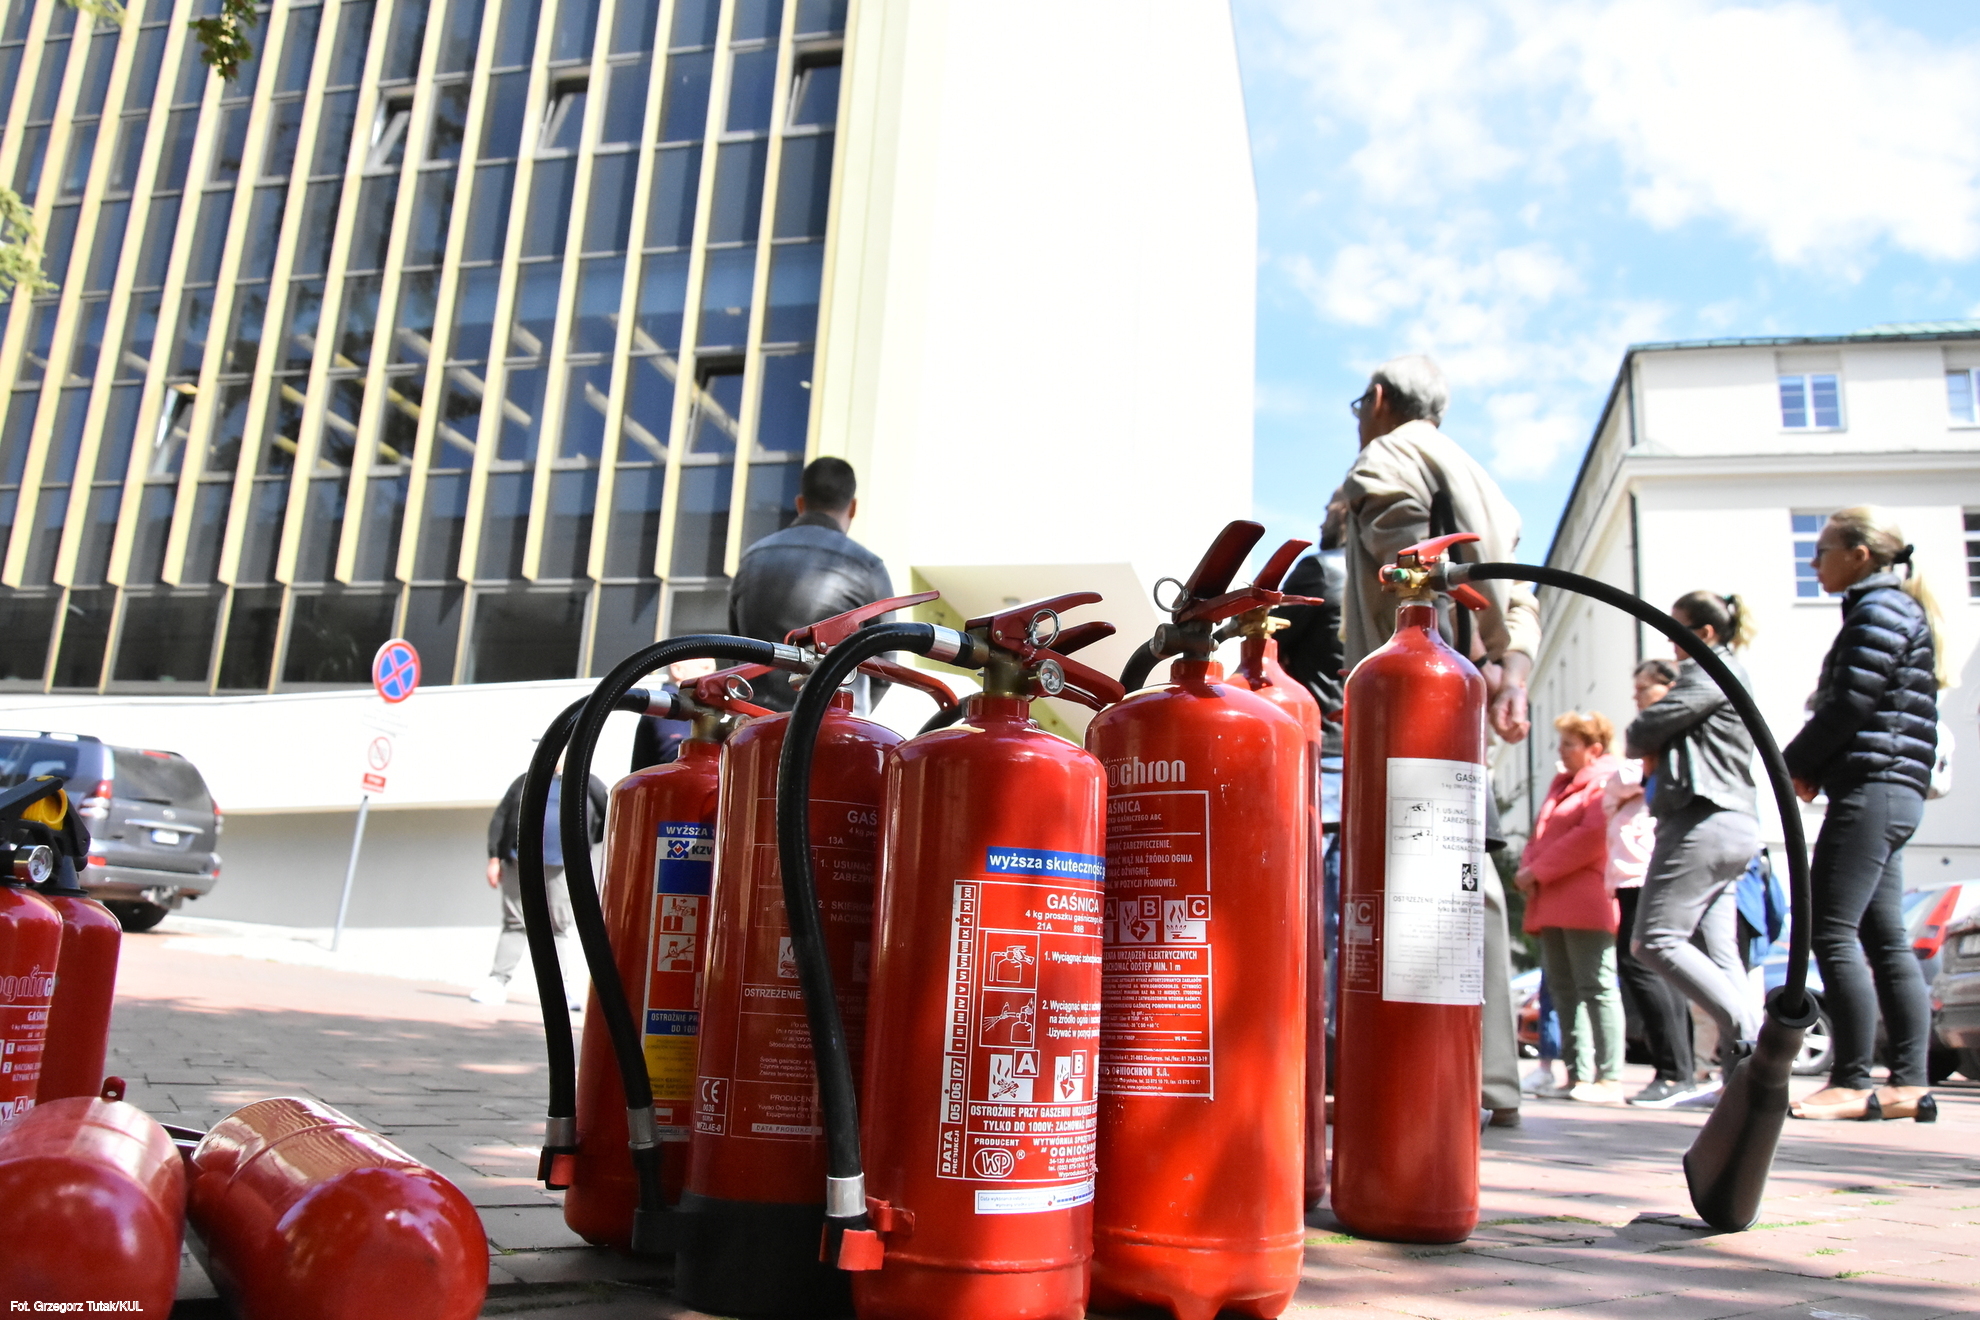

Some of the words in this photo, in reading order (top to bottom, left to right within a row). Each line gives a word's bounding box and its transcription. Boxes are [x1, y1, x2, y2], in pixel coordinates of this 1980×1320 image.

[1107, 756, 1186, 788] ochron
[1107, 800, 1141, 814] AŚNICA
[1150, 813, 1162, 821] ABC
[666, 825, 708, 837] WYŻSZA
[828, 837, 844, 845] 13A
[820, 859, 828, 868] 1.
[1135, 855, 1144, 864] NA
[1145, 852, 1169, 863] ŹRÓDŁO
[1171, 854, 1193, 863] OGNIA
[989, 853, 1043, 870] wyższa
[1046, 857, 1102, 876] skuteczność
[1143, 878, 1178, 888] PIONOWEJ.
[964, 887, 972, 898] XII
[963, 902, 971, 911] XI
[1046, 892, 1100, 914] GAŚNICA
[1143, 900, 1156, 916] B
[1191, 899, 1206, 916] C
[1025, 909, 1031, 918] 4
[1033, 910, 1043, 920] kg
[1044, 911, 1073, 921] proszku
[1104, 902, 1114, 918] A
[1357, 902, 1371, 923] C
[1036, 921, 1053, 931] 21A
[962, 929, 970, 939] IX
[960, 955, 968, 967] VII
[1044, 951, 1051, 960] 1.
[1147, 950, 1198, 960] ELEKTRYCZNYCH
[1130, 962, 1151, 974] ODSTĘP
[1153, 962, 1168, 972] MIN.
[960, 971, 967, 981] VI
[958, 999, 966, 1008] IV
[1042, 999, 1049, 1010] 2.
[651, 1012, 687, 1022] OSTROŻNIE
[957, 1012, 965, 1022] III
[1049, 1016, 1058, 1024] na
[1058, 1013, 1076, 1024] źródło
[671, 1025, 681, 1033] DO
[952, 1060, 963, 1077] 07
[1016, 1052, 1037, 1074] A
[1075, 1054, 1084, 1074] B
[1156, 1067, 1170, 1077] S.A.
[951, 1082, 962, 1099] 06
[16, 1099, 25, 1114] A
[949, 1103, 961, 1121] 05
[970, 1102, 1016, 1118] OSTROŻNIE
[1018, 1107, 1039, 1118] PRZY
[1040, 1106, 1071, 1118] GASZENIU
[756, 1124, 773, 1132] DATA
[983, 1120, 1012, 1131] TYLKO
[1014, 1120, 1026, 1132] DO
[1028, 1120, 1054, 1133] 1000V;
[974, 1137, 1020, 1147] PRODUCENT
[1033, 1135, 1074, 1147] WYTWÓRNIA
[941, 1130, 954, 1174] DATA
[981, 1151, 1010, 1176] WSP
